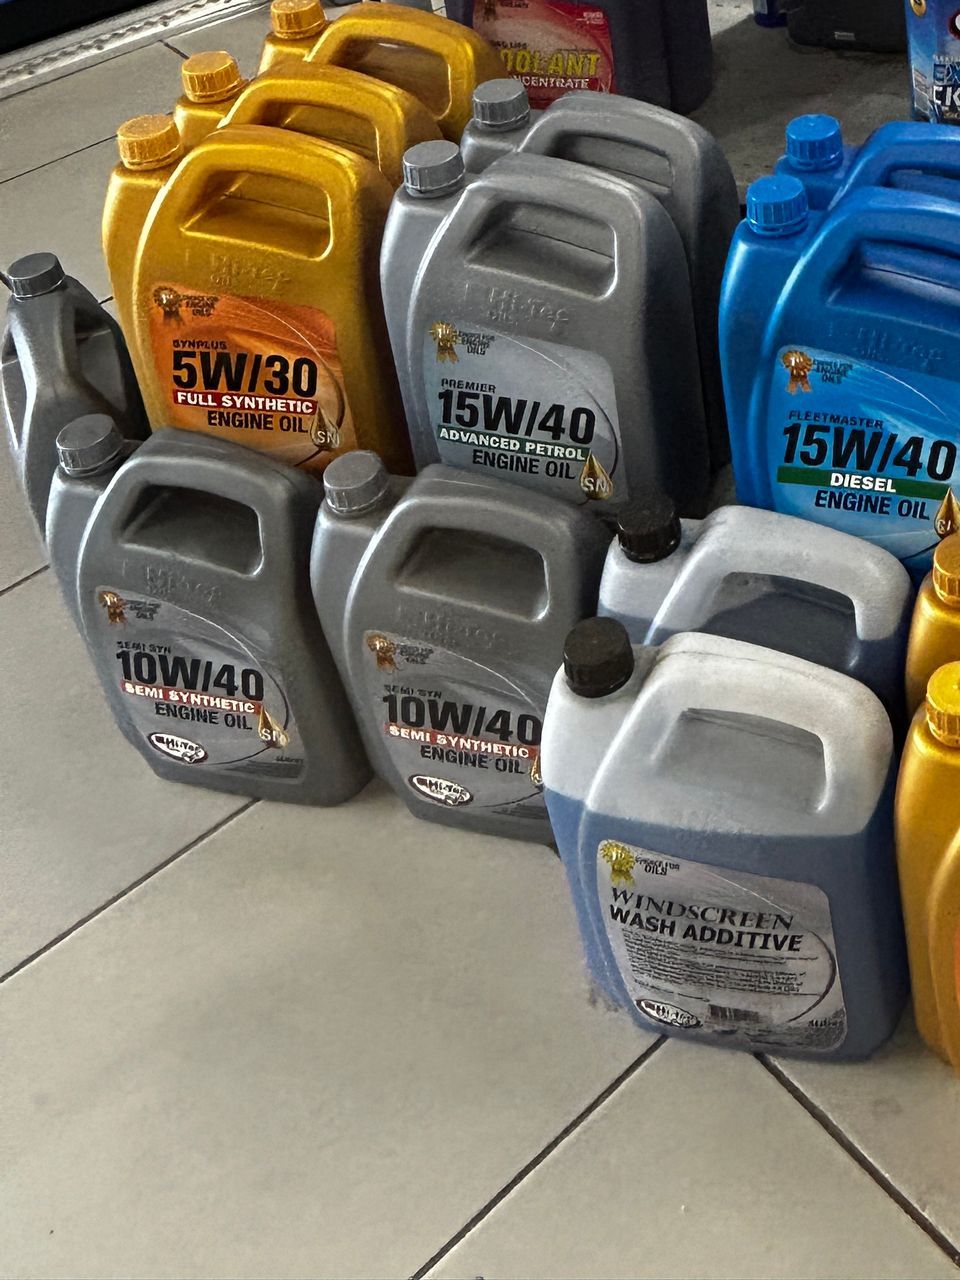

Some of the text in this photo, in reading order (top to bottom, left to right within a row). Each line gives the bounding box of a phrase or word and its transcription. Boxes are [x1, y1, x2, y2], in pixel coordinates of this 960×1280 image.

[172, 339, 228, 350] SYNPLUS
[172, 350, 318, 398] 5W/30
[441, 378, 497, 394] PREMIER
[177, 391, 314, 414] FULL SYNTHETIC
[438, 389, 597, 445] 15W/40
[207, 410, 309, 434] ENGINE OIL
[788, 410, 884, 429] FLEETMASTER
[439, 427, 586, 461] ADVANCED PETROL
[782, 422, 957, 482] 15W/40
[472, 449, 577, 480] ENGINE OIL
[830, 472, 896, 493] DIESEL
[814, 489, 930, 520] ENGINE OIL
[116, 640, 172, 654] SEMI SYN
[116, 650, 264, 701] 10W/40
[125, 682, 255, 713] SEMI SYNTHETIC
[383, 684, 442, 699] SEMI SYN
[155, 702, 252, 730] ENGINE OIL
[382, 694, 542, 746] 10W/40
[389, 725, 529, 758] SEMI SYNTHETIC
[420, 745, 525, 774] ENGINE OIL
[611, 886, 793, 931] WINDSCREEN
[610, 904, 803, 952] WASH ADDITIVE
